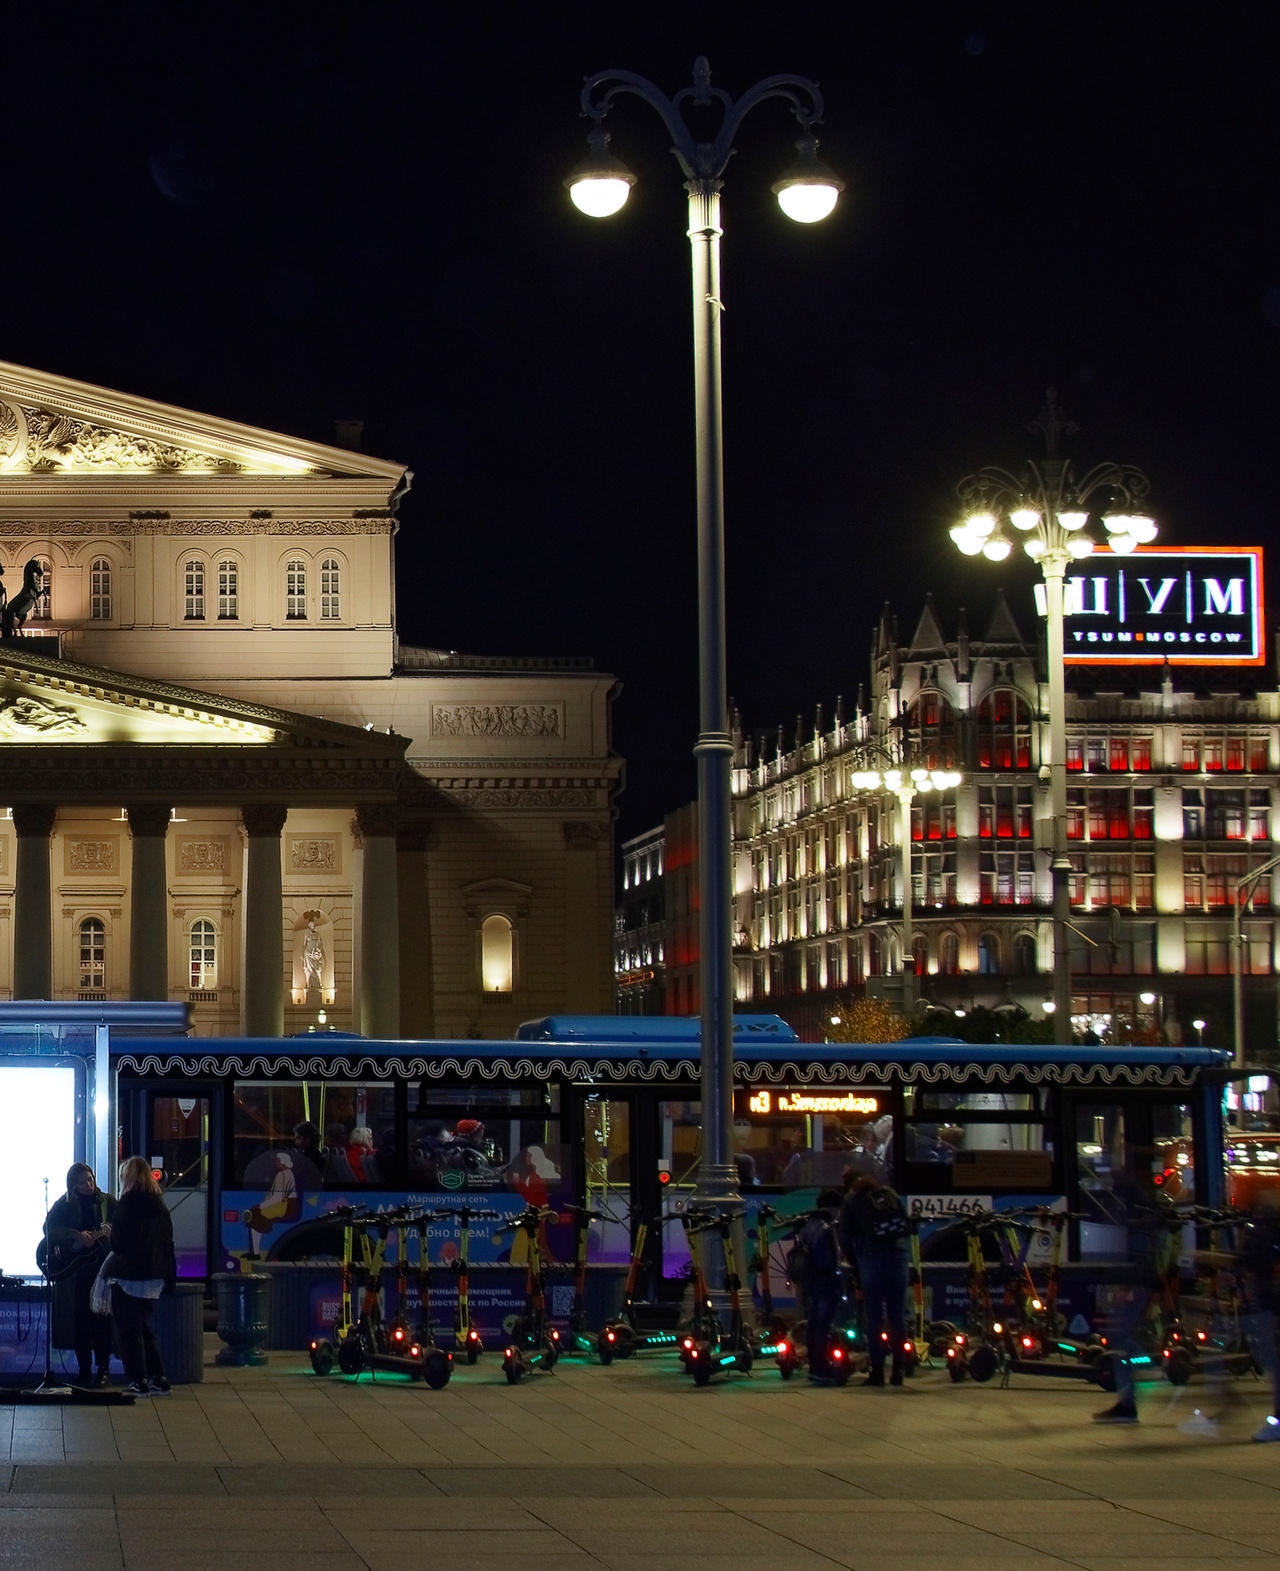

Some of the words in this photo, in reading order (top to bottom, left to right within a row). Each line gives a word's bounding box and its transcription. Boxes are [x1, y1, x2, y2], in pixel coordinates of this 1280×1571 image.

[1073, 631, 1132, 642] TSUM
[1146, 631, 1242, 642] MOSCOW
[407, 1195, 468, 1205] Маршрутная
[469, 1196, 489, 1204] сеть
[453, 1226, 490, 1238] вем!
[427, 1286, 460, 1296] ичный
[466, 1288, 512, 1297] омощник
